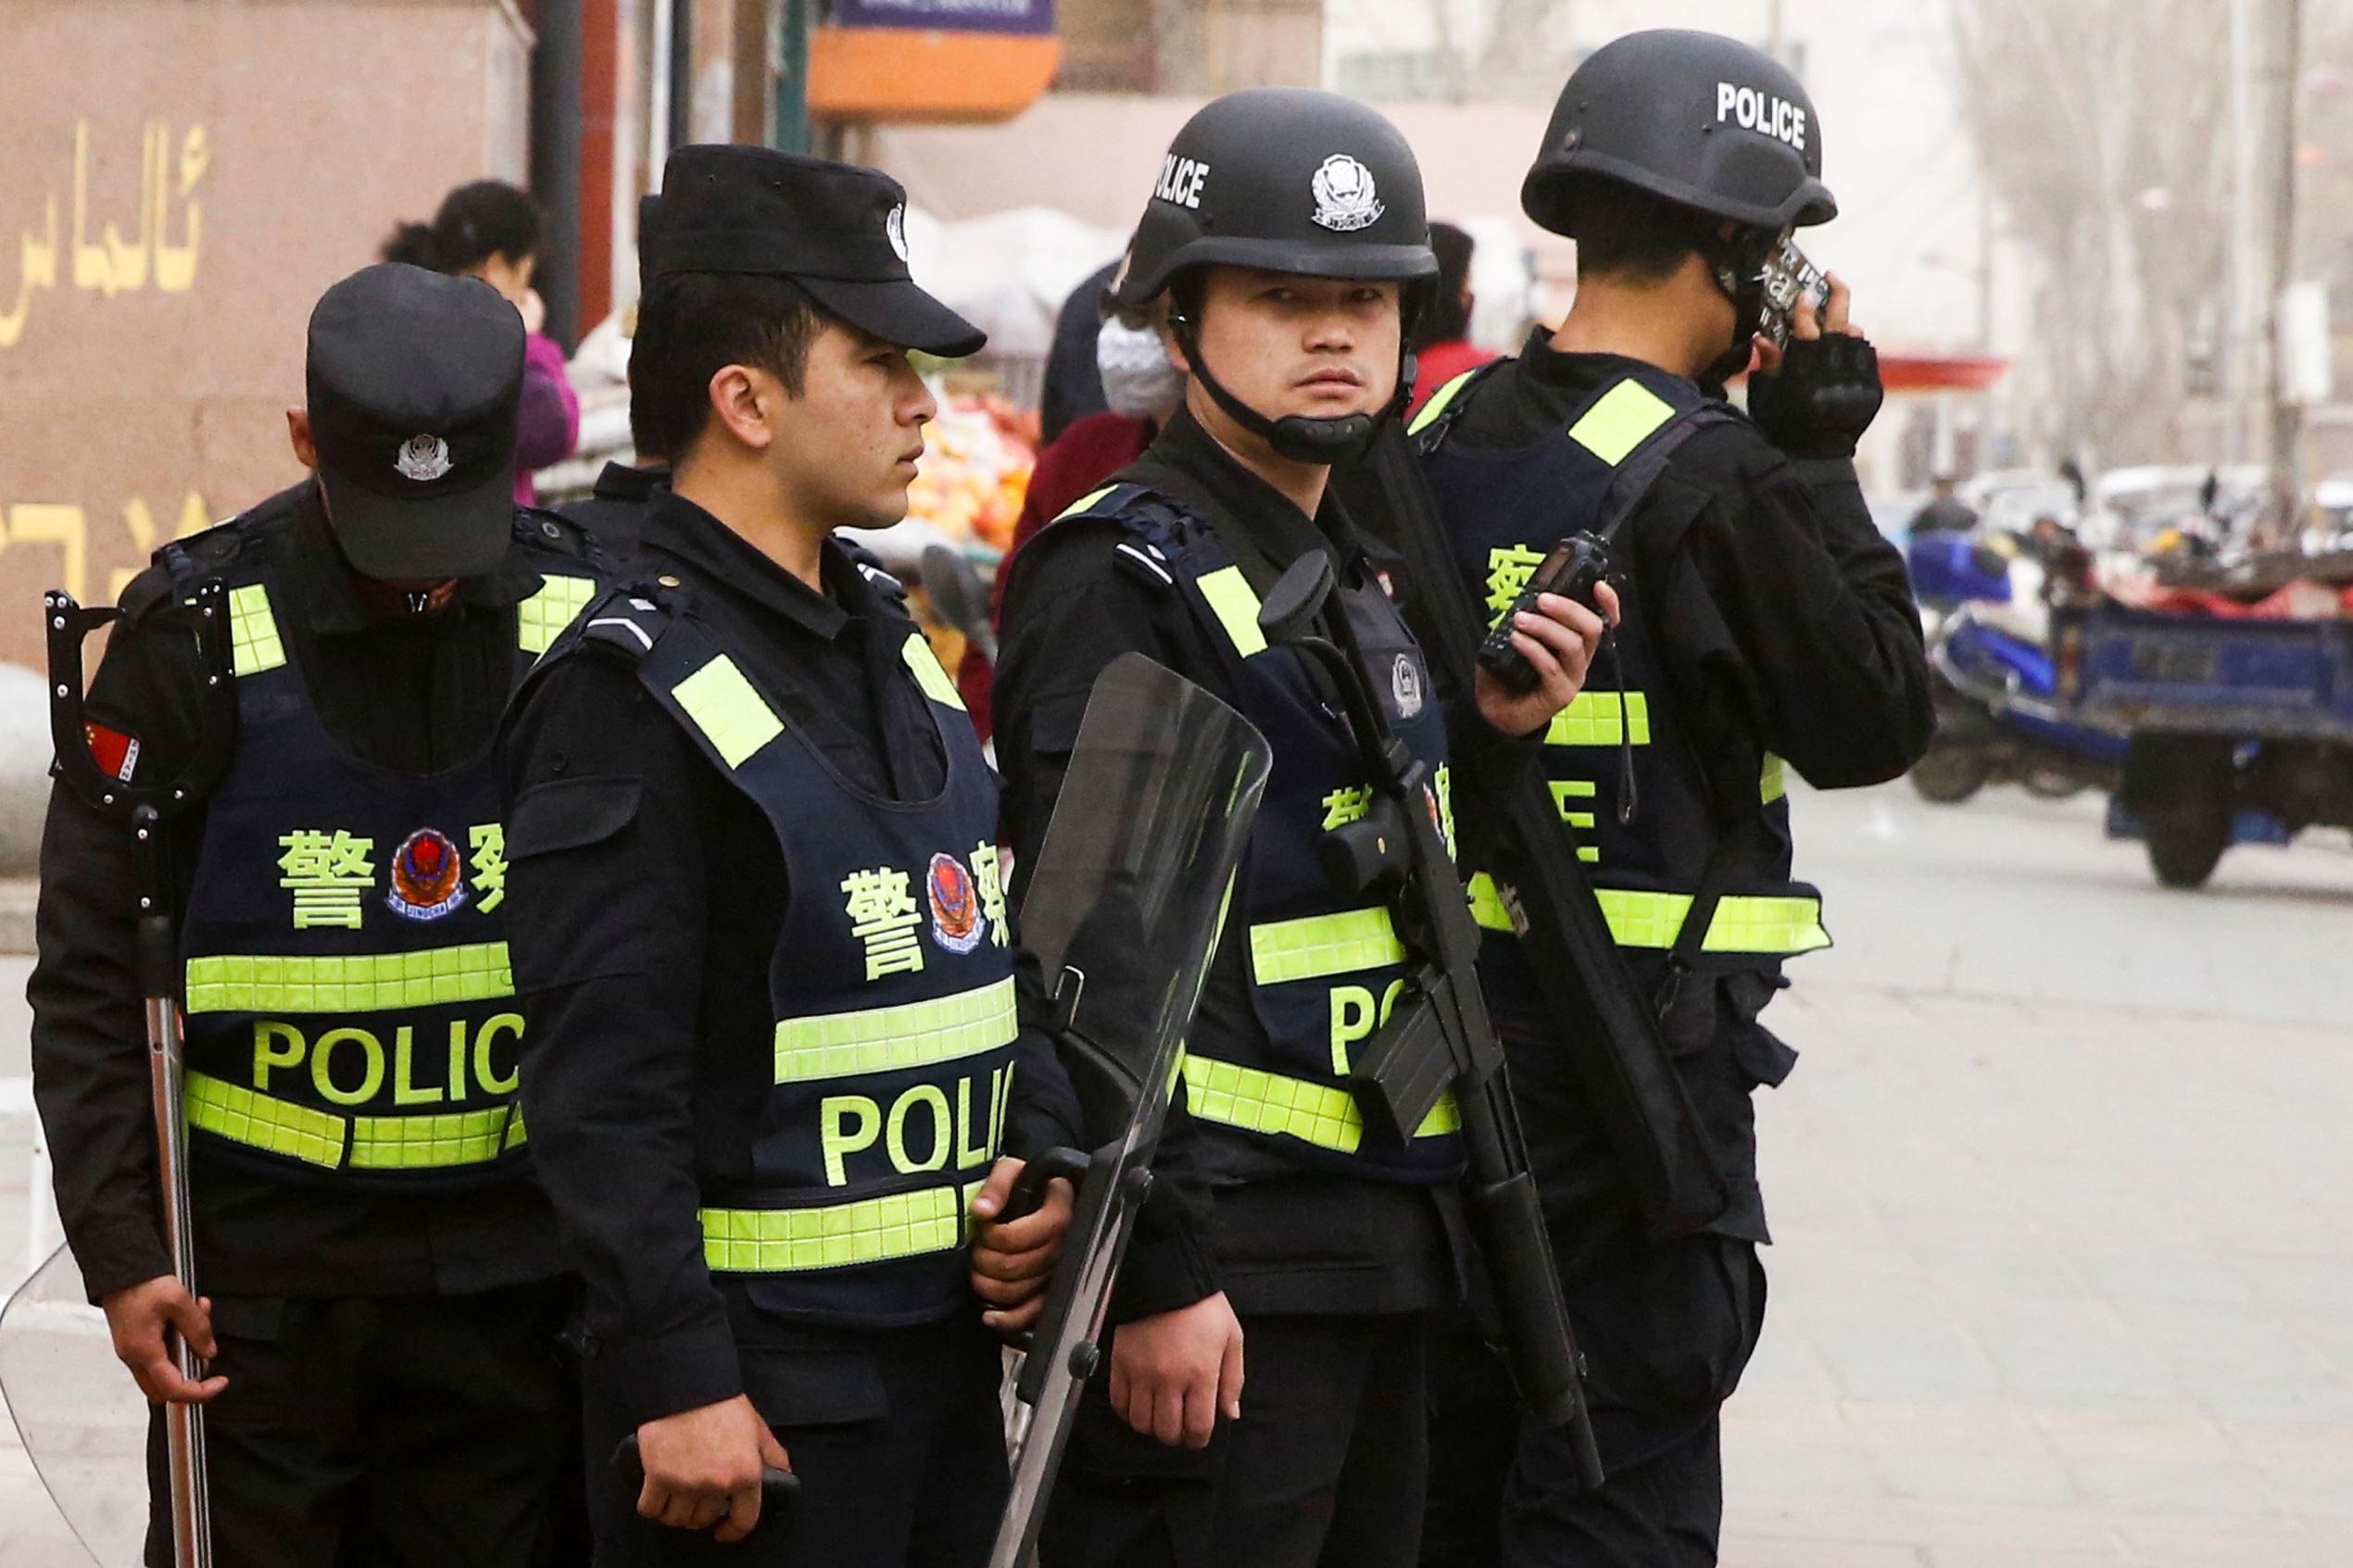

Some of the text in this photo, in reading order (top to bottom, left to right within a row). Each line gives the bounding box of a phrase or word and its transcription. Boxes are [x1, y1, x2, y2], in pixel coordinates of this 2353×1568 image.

[1717, 82, 1806, 150] POLICE
[277, 829, 375, 930] 警
[840, 866, 925, 982] 警
